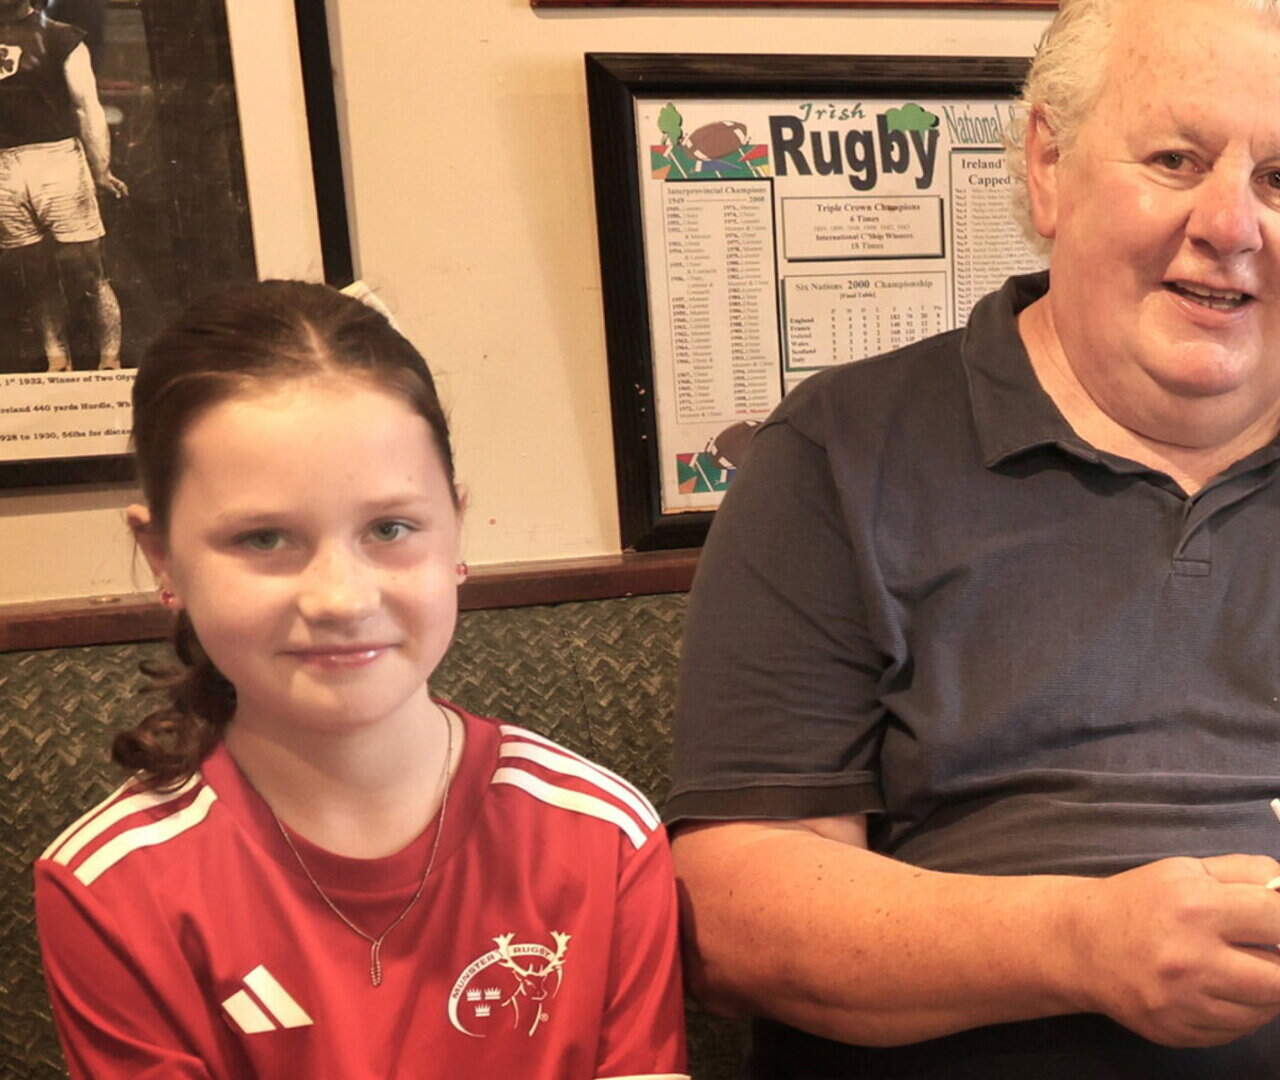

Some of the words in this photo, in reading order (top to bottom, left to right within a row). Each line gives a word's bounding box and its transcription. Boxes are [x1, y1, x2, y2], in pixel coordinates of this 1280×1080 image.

[799, 102, 866, 122] Irish
[942, 104, 1005, 144] National
[769, 113, 941, 191] Rugby
[962, 157, 1007, 169] Ireland'
[968, 173, 1011, 188] Capped
[816, 204, 842, 213] Triple
[844, 203, 872, 212] Crown
[857, 215, 880, 223] Times
[795, 283, 809, 291] Six
[810, 282, 843, 290] Nations
[847, 280, 871, 290] 2000
[874, 279, 934, 290] Championship
[452, 954, 496, 1000] MUNSTER
[513, 946, 550, 958] RUGBY
